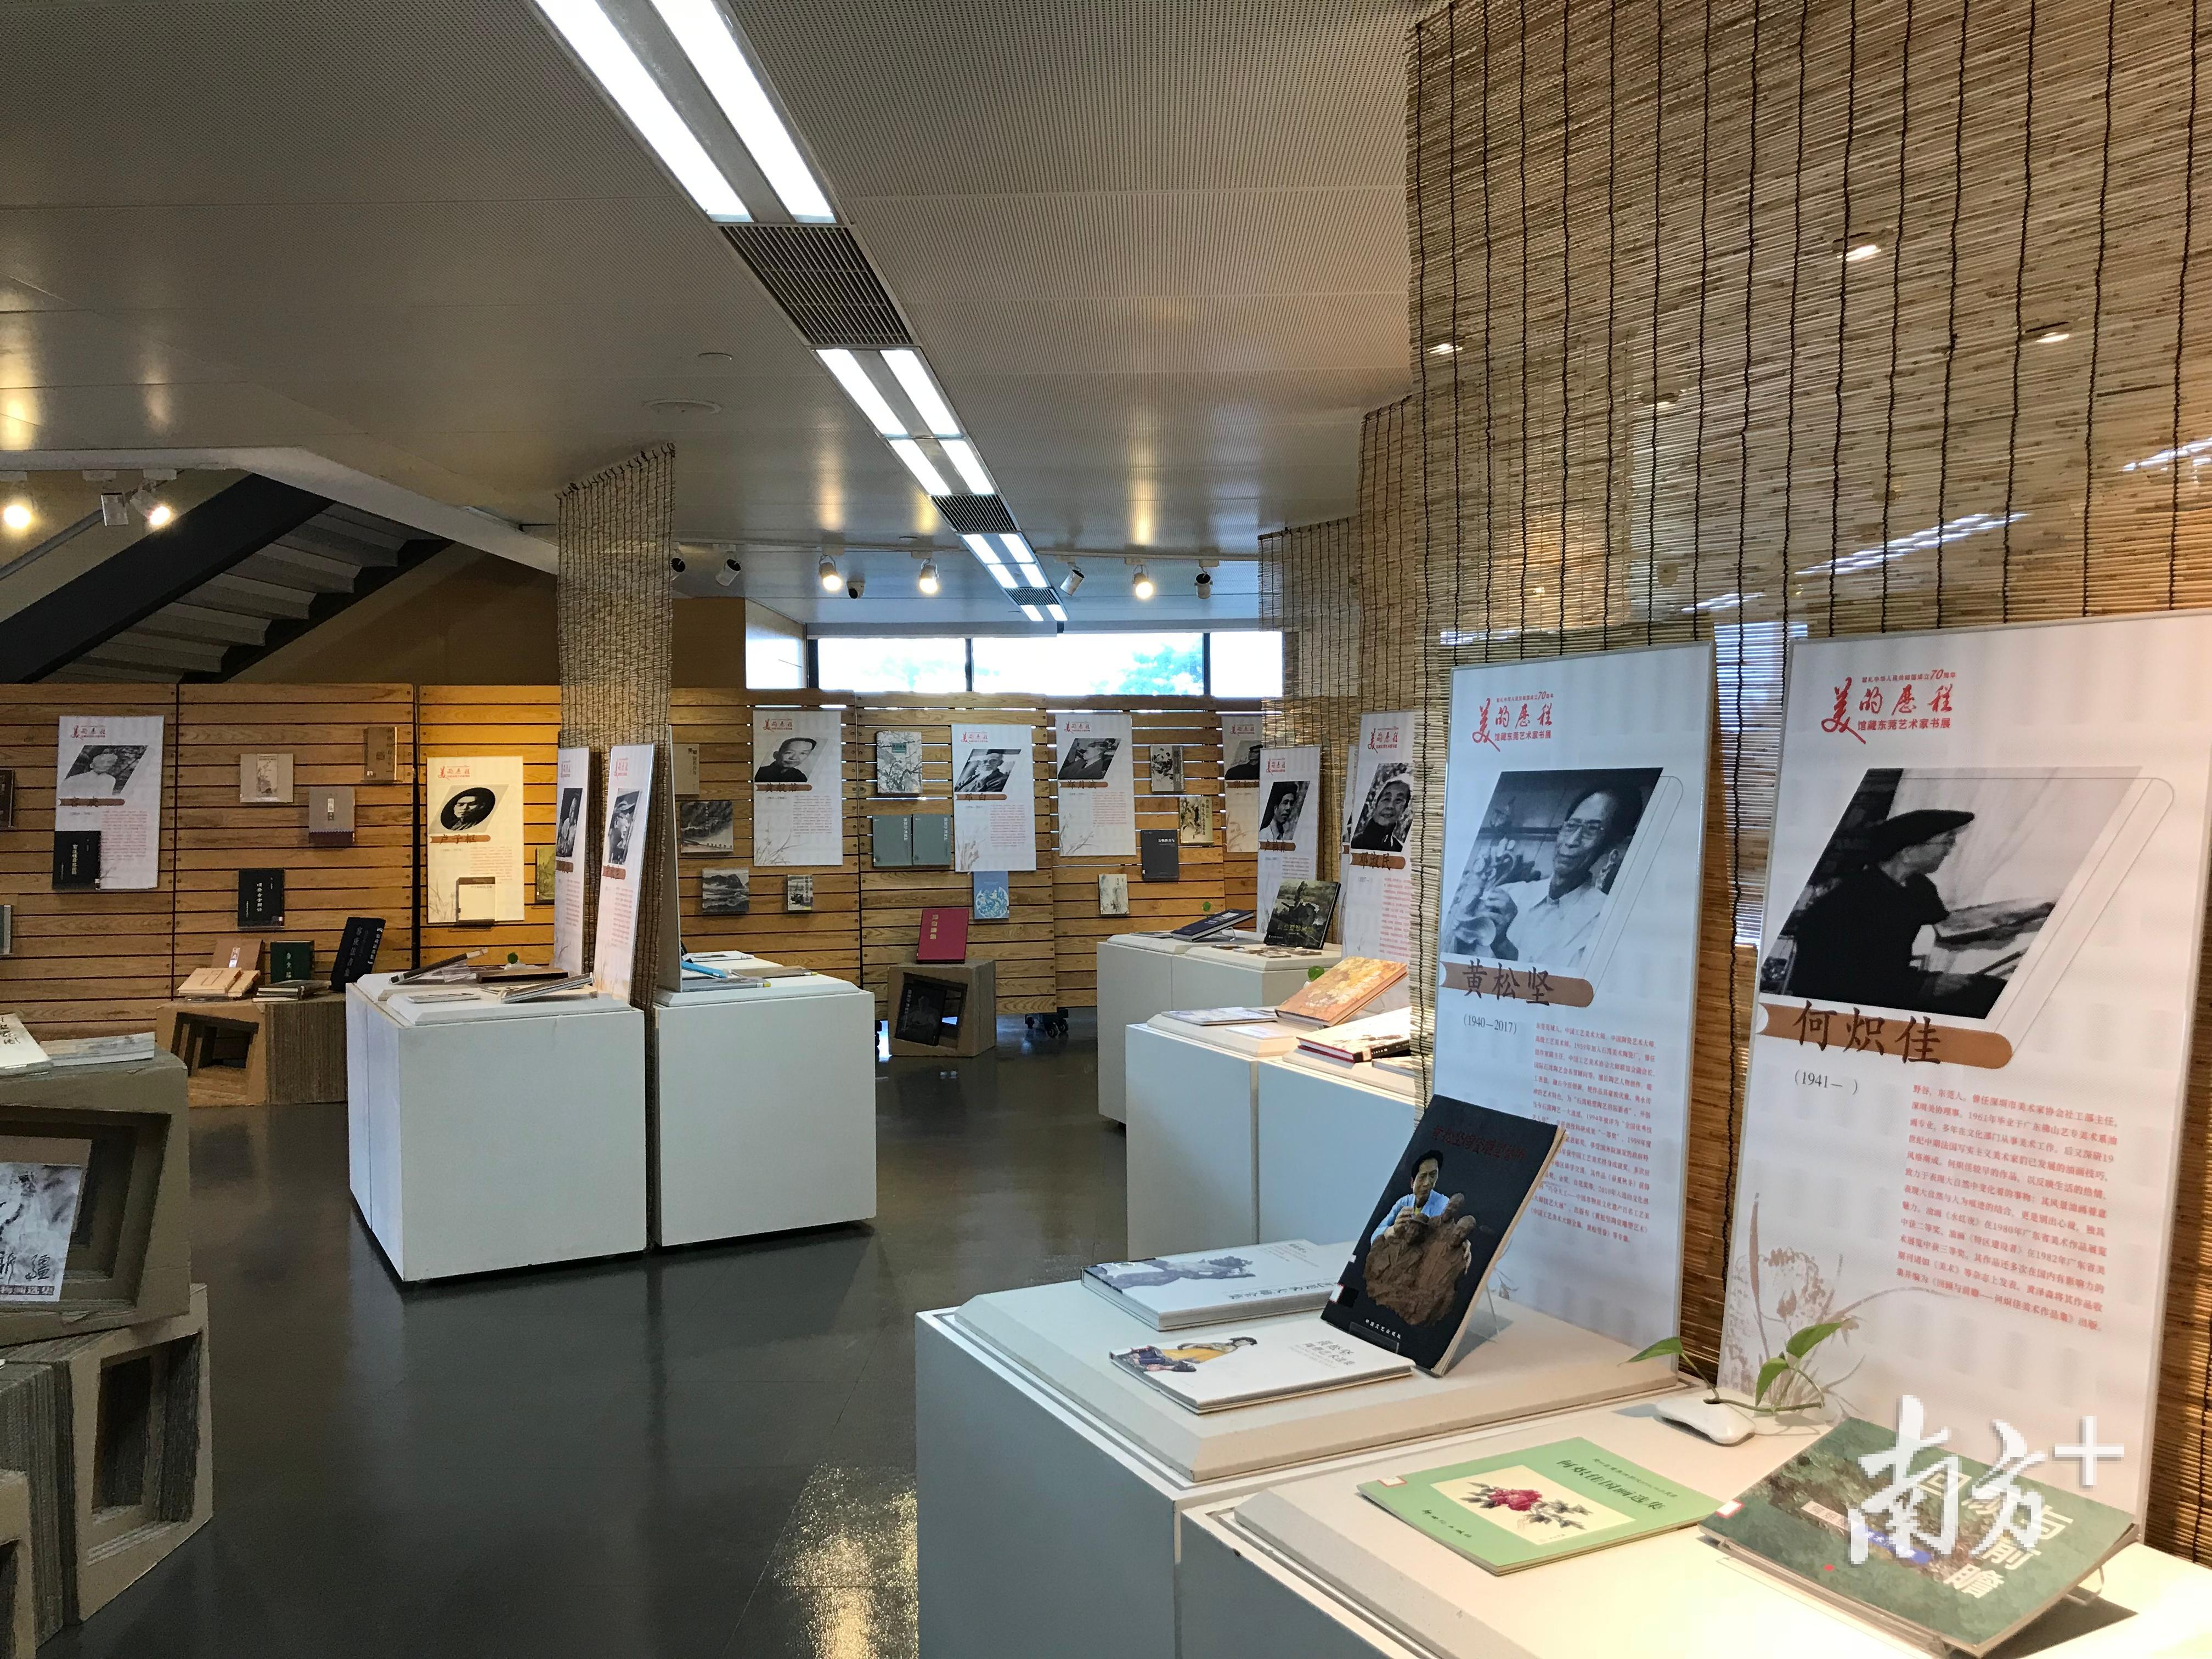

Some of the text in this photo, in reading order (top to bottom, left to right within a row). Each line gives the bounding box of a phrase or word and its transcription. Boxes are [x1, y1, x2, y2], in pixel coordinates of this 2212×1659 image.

[1494, 730, 1551, 741] 馆藏东莞艺术家书展
[1858, 718, 1951, 731] 馆藏东莞艺术家书展
[1462, 958, 1554, 1006] 黄松坚
[1792, 1000, 1941, 1064] 何炽佳
